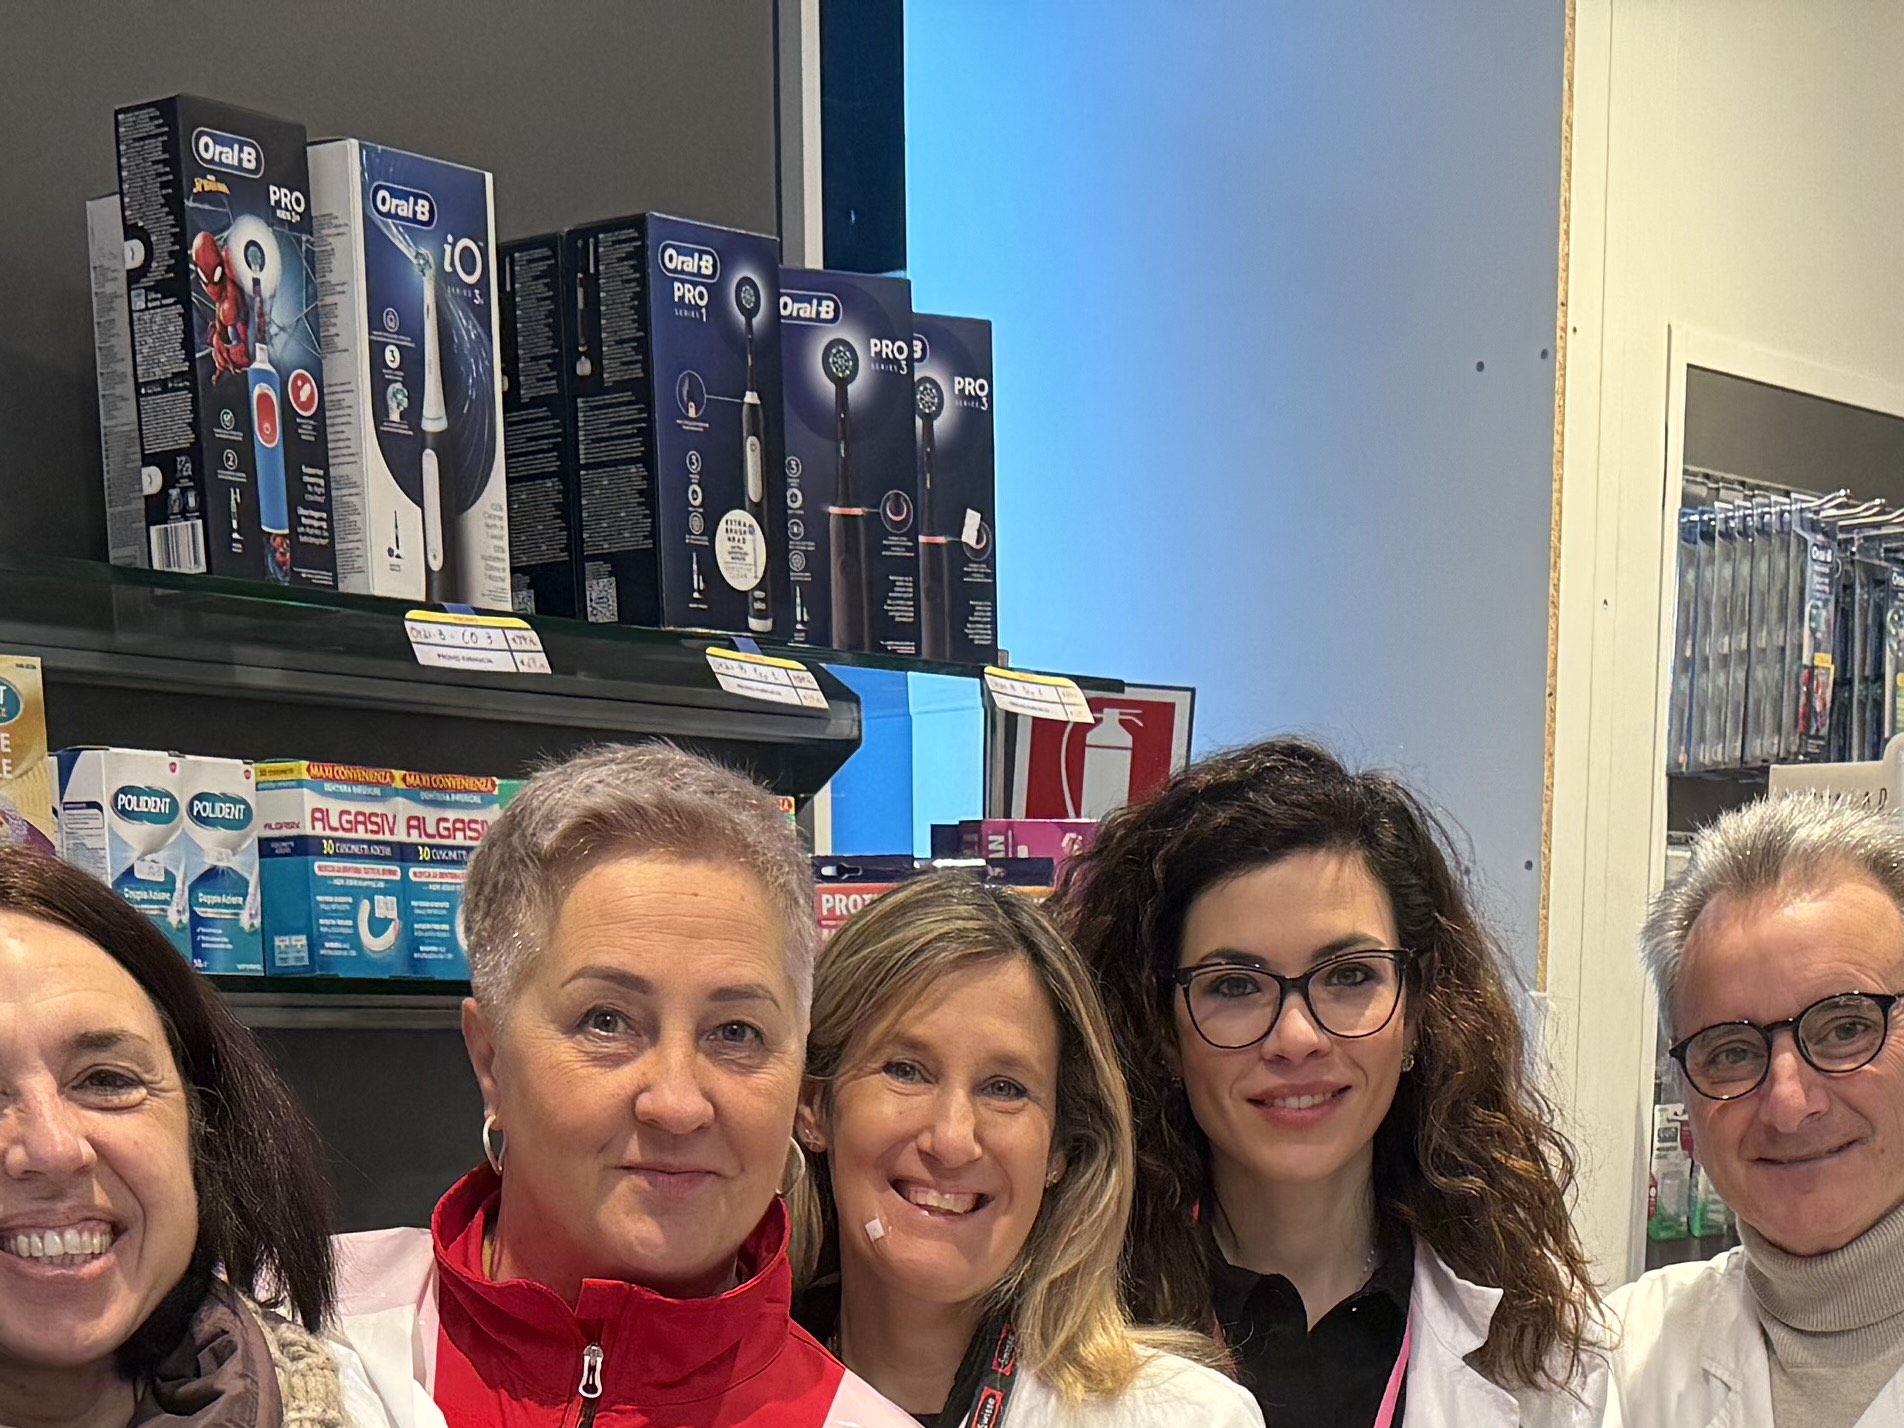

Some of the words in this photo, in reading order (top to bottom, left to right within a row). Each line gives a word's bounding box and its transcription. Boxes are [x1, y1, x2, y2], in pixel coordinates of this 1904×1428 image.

[269, 185, 305, 212] PRO
[673, 282, 708, 308] PRO
[116, 793, 176, 818] POLIDENT
[311, 808, 397, 837] ALGASIV
